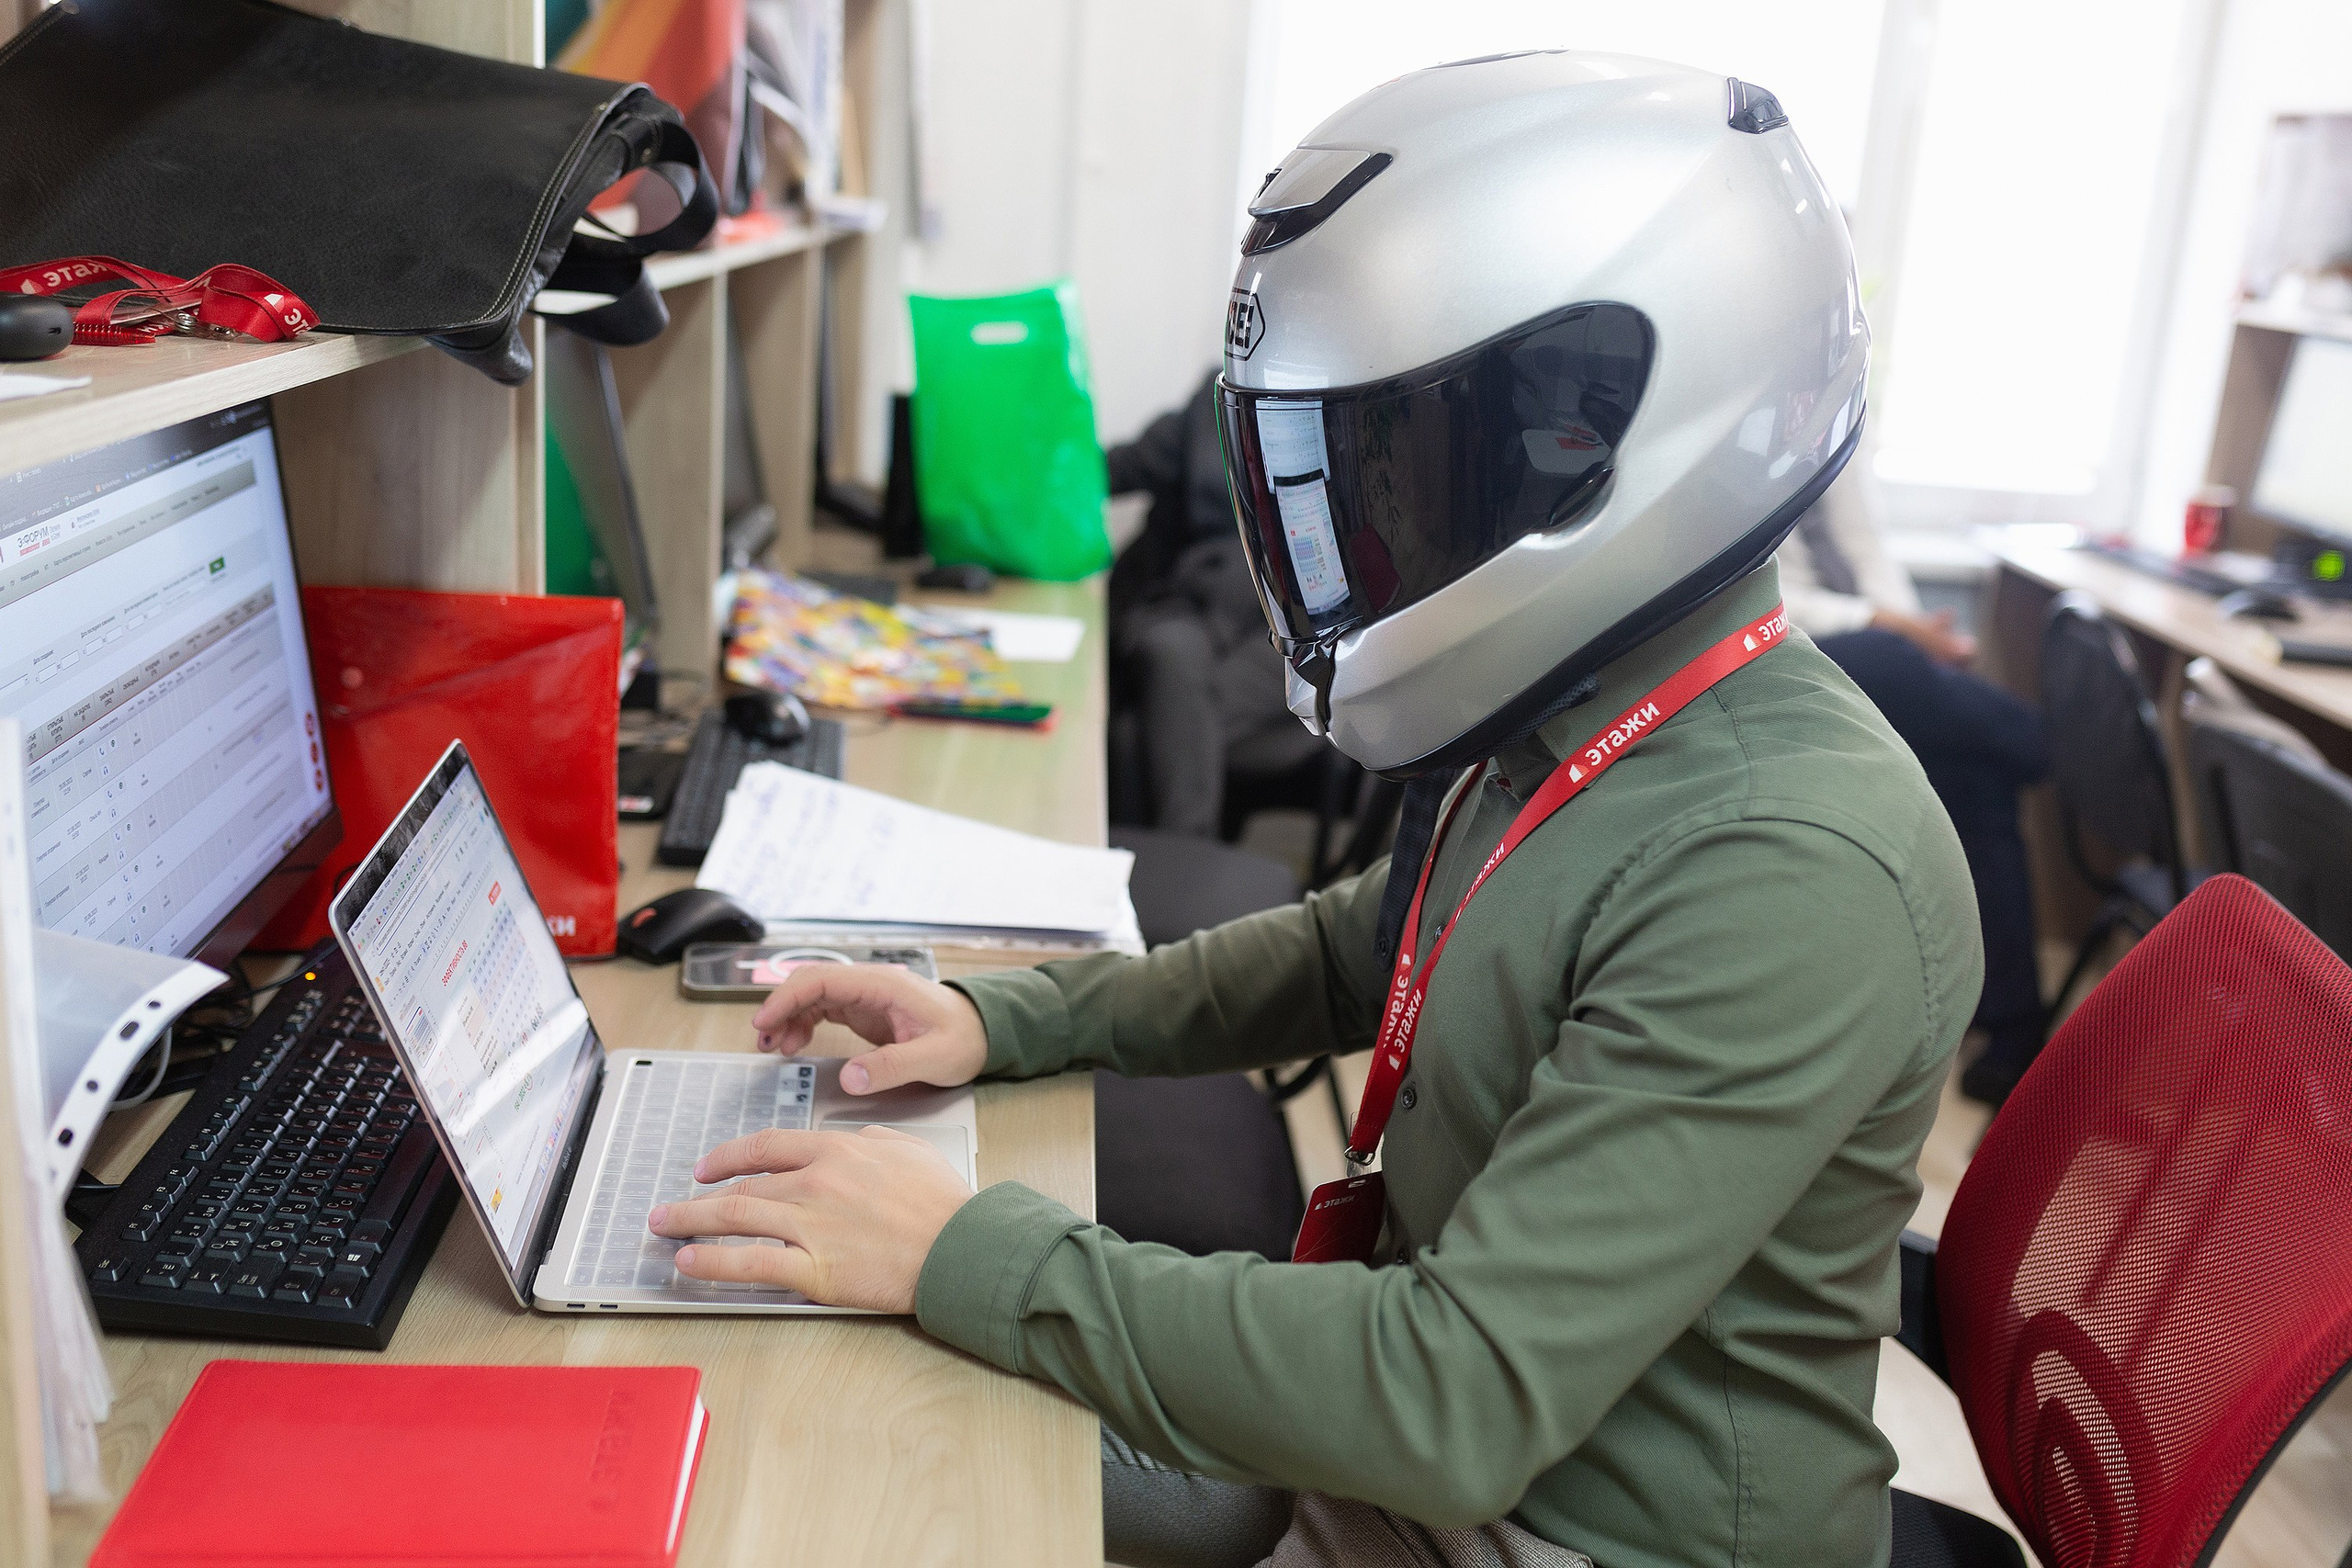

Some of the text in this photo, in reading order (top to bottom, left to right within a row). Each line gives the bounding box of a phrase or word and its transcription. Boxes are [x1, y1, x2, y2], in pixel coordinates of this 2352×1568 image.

[42, 262, 108, 288] этаж
[1758, 611, 1789, 641] этаж
[1585, 702, 1660, 766] этажи
[1394, 988, 1422, 1054] этажи
